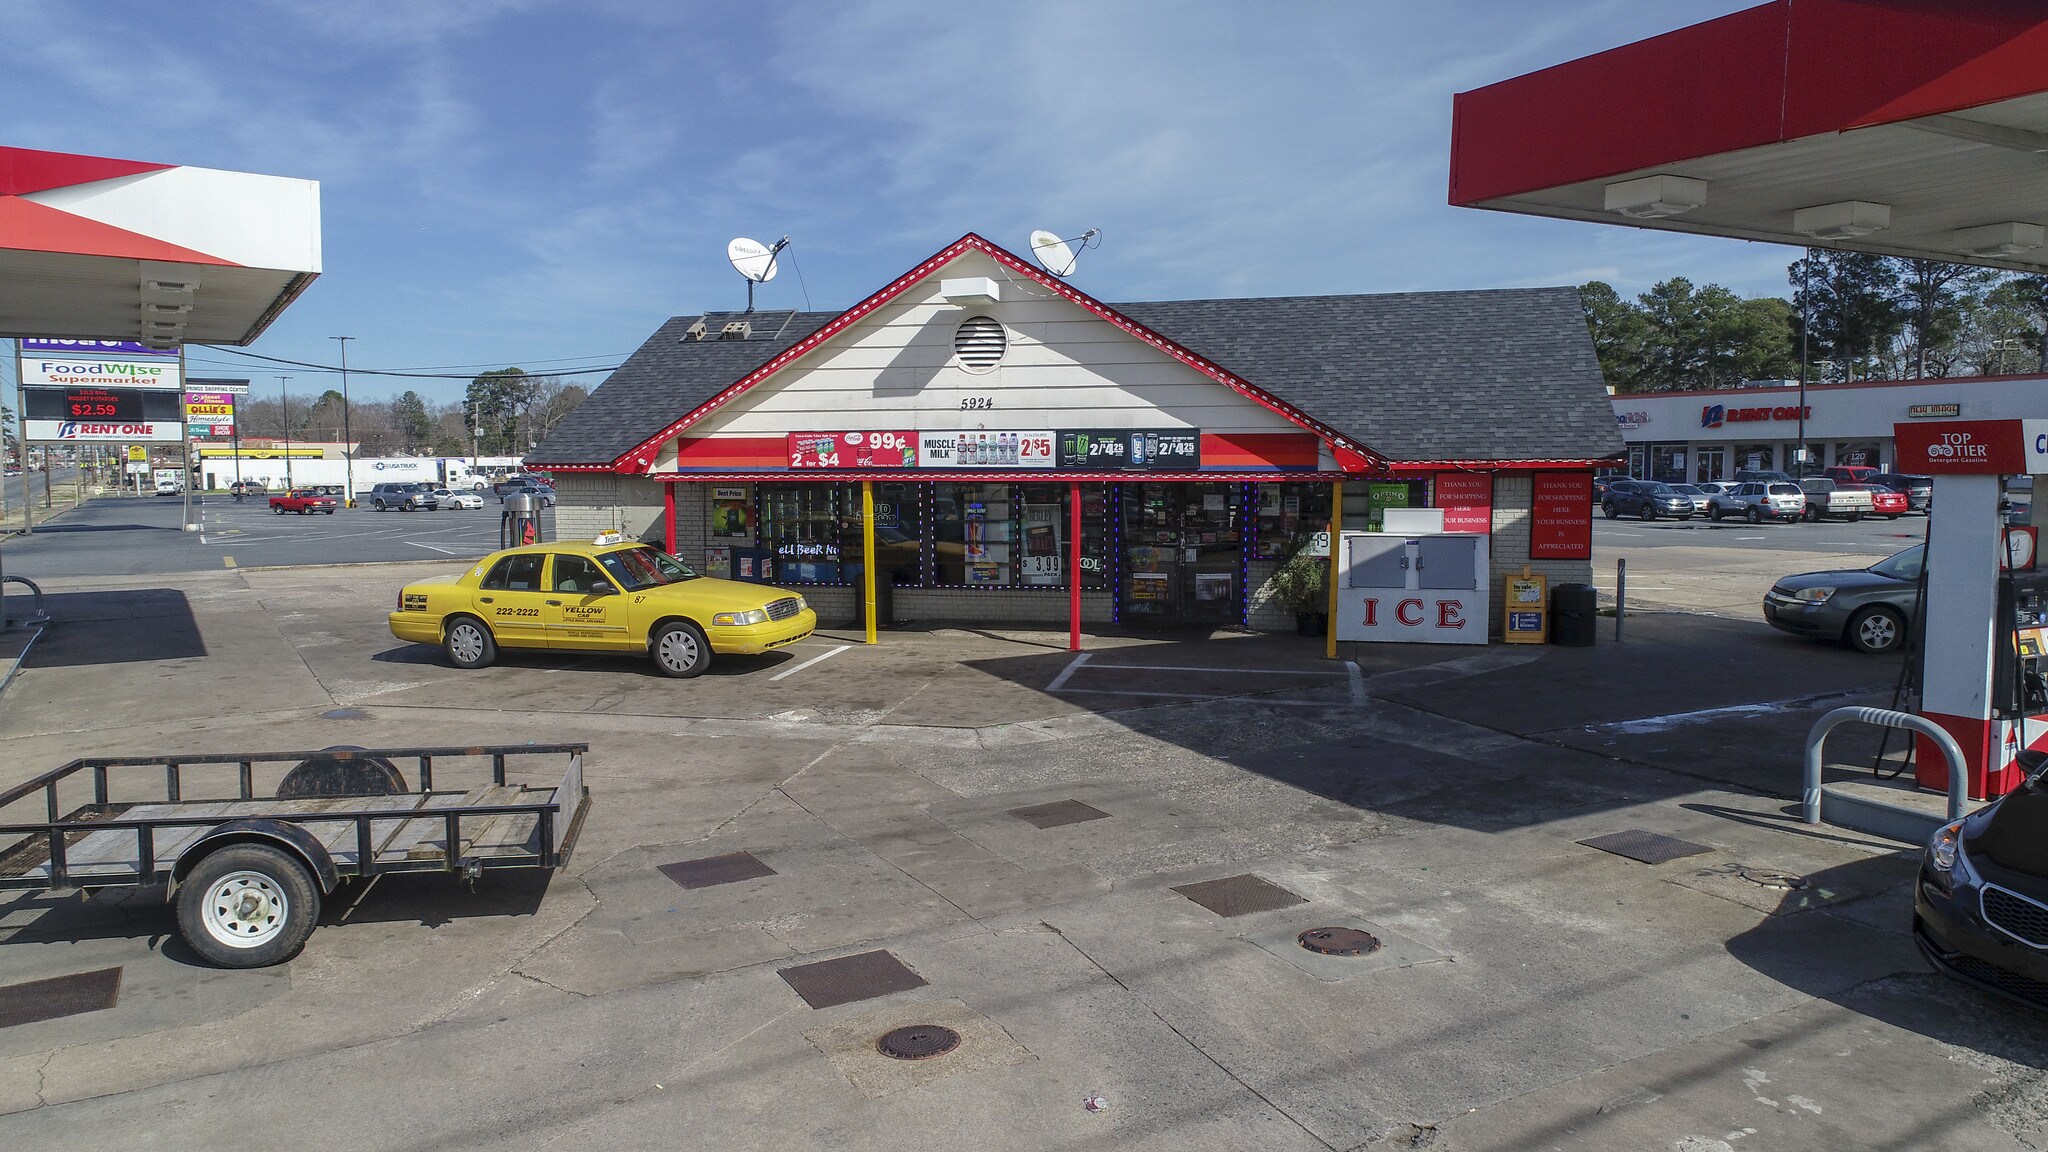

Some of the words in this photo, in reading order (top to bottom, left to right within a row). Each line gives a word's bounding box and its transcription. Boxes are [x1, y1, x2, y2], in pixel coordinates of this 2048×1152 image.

[49, 375, 158, 385] Supermarket
[72, 403, 116, 416] $2.59
[960, 397, 993, 411] 5924
[1726, 407, 1772, 422] RENT
[81, 424, 119, 434] RENT
[122, 424, 153, 434] ONE
[924, 439, 955, 448] MUSCLE
[1941, 433, 1971, 444] TOP
[1021, 438, 1051, 457] 2/$5
[1954, 444, 1987, 456] TIER
[930, 449, 950, 458] MILK
[1850, 452, 1866, 460] 120
[792, 453, 802, 467] 2
[818, 452, 839, 467] $4
[1373, 491, 1405, 500] OPTIMO
[1022, 559, 1028, 568] $
[1036, 556, 1059, 572] 3.99
[1080, 557, 1101, 571] OOL
[634, 596, 646, 604] 87
[496, 607, 539, 617] 222-2222
[565, 606, 603, 614] YELLOW
[1363, 598, 1466, 630] ICE
